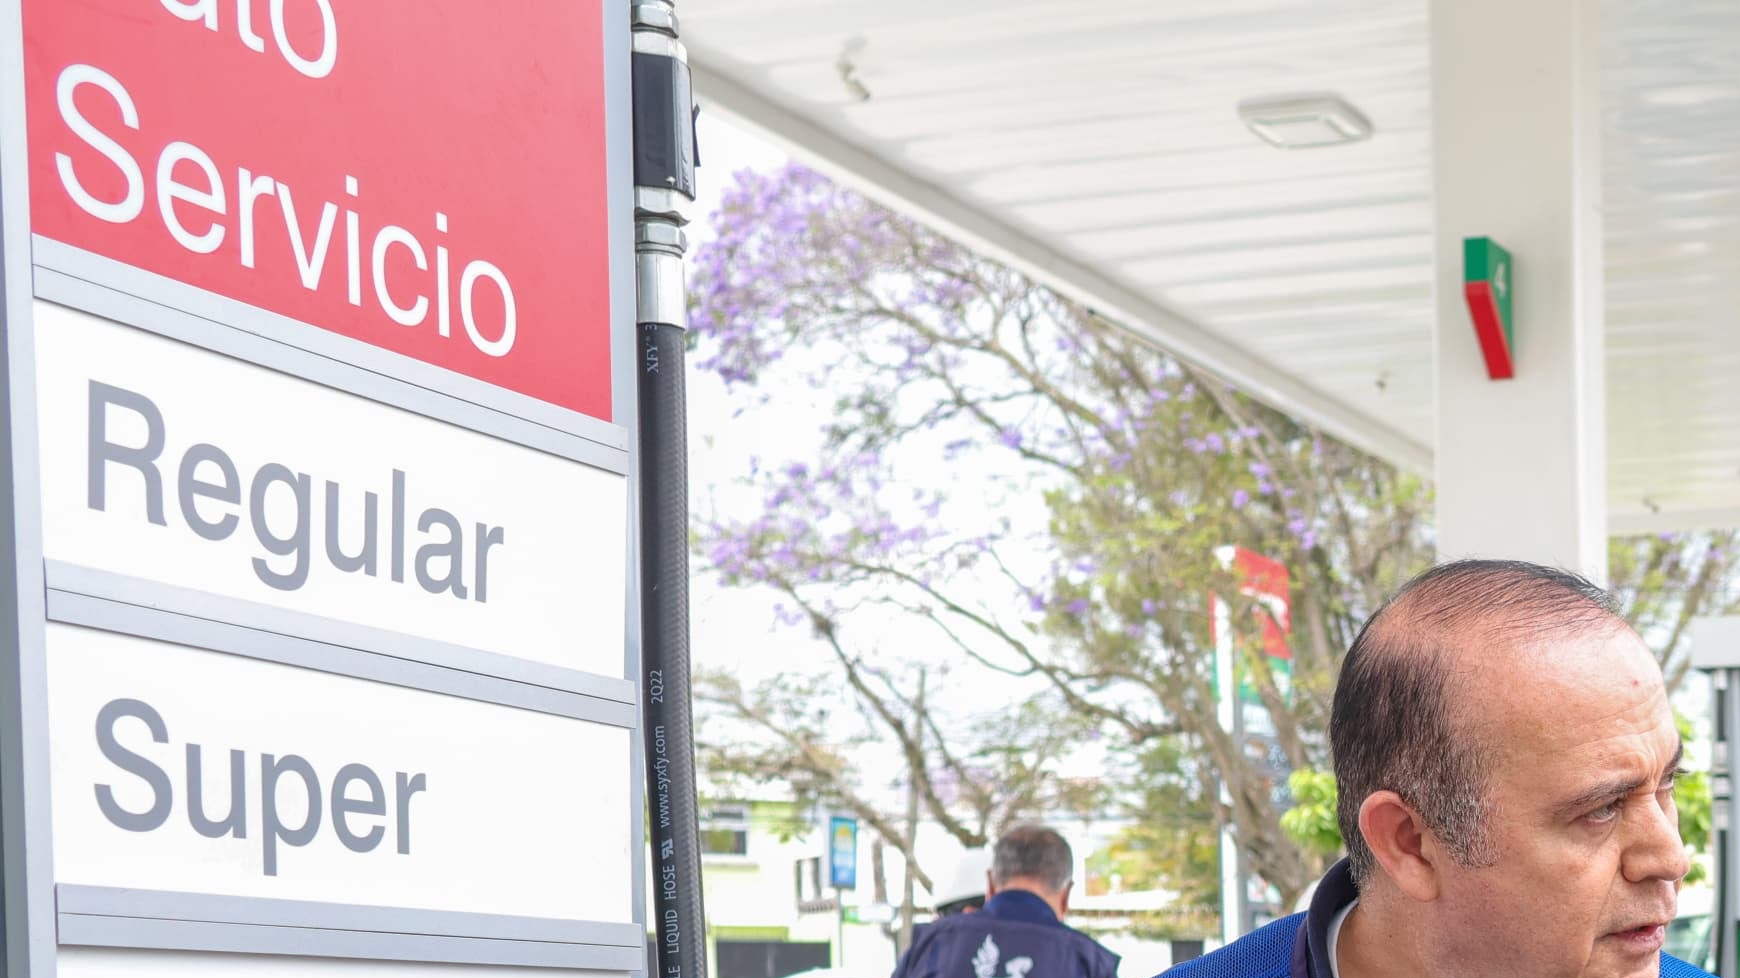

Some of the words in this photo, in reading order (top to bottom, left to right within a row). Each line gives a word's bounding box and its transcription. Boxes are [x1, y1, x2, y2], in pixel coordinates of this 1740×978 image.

[56, 64, 517, 357] Servicio
[87, 378, 504, 603] Regular
[649, 669, 664, 704] 2Q22
[94, 699, 427, 876] Super
[653, 725, 671, 828] www.syxfy.com
[662, 865, 677, 900] HOSE
[664, 909, 680, 953] LIQUID
